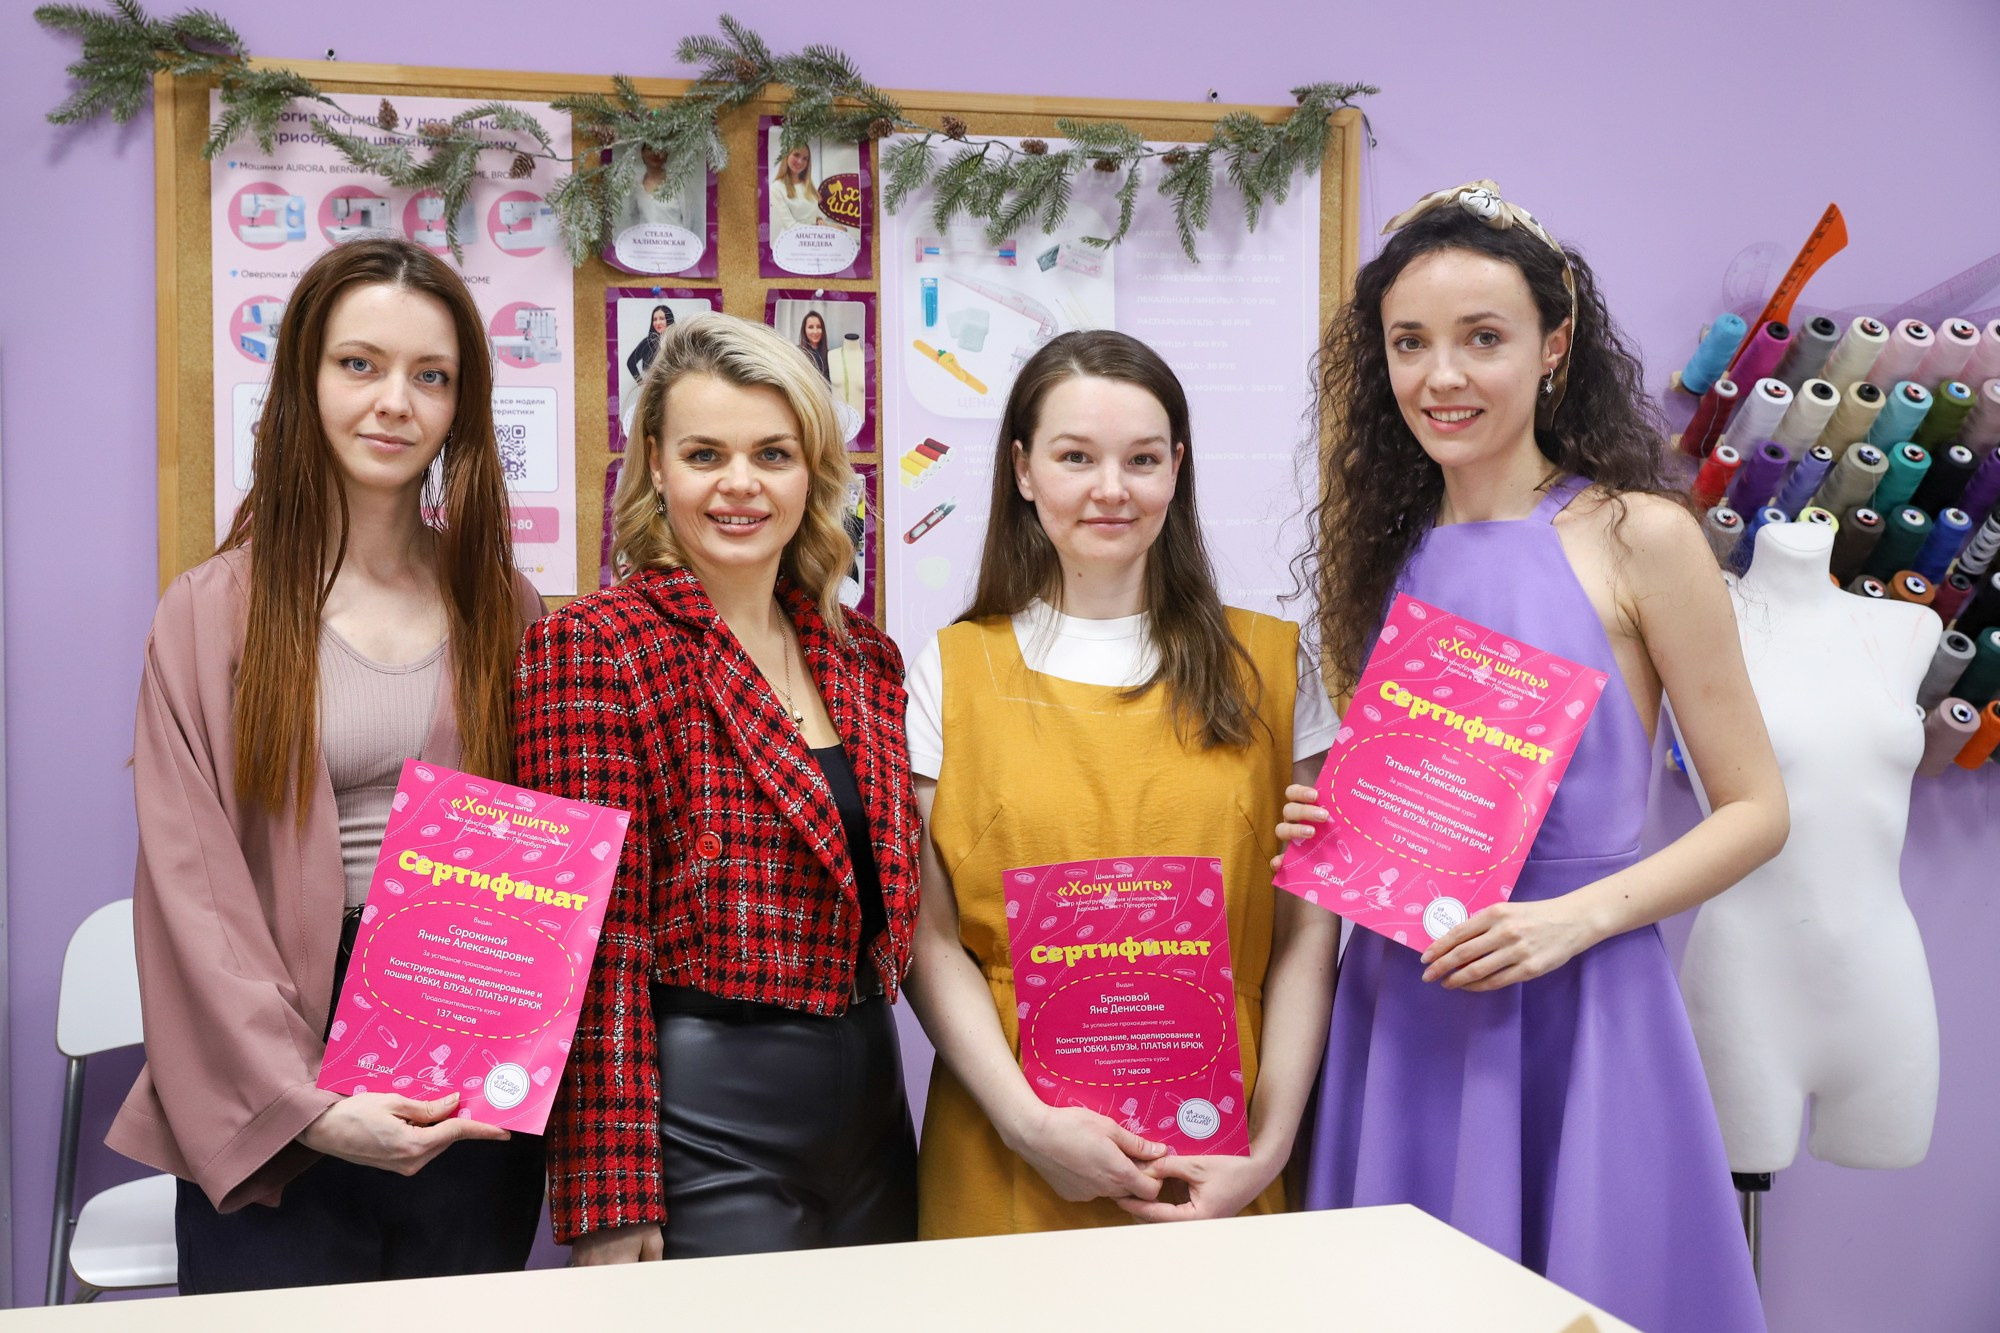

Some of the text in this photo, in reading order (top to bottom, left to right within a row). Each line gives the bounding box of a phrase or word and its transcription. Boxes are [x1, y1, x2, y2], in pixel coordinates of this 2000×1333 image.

[240, 162, 284, 171] Машинки
[644, 230, 674, 238] СТЕЛЛА
[795, 232, 836, 240] АНАСТАСИЯ
[632, 238, 686, 247] ХАЛИМОВСКАЯ
[797, 240, 833, 248] ЛЕБЕДЕВА
[241, 269, 288, 279] Оверлоки
[515, 398, 546, 407] модели
[1438, 637, 1549, 689] «Хочу шить»
[1441, 754, 1459, 766] Выдан
[1420, 758, 1467, 785] Покотило
[1385, 755, 1496, 810] Татьяне Александровне
[494, 798, 514, 808] Школа
[1396, 781, 1424, 796] успешное
[1423, 793, 1461, 812] прохождение
[1461, 809, 1477, 819] курса
[451, 795, 570, 835] «Хочу шить»
[1357, 777, 1426, 814] Конструирование,
[1426, 809, 1488, 840] моделирование
[1350, 788, 1492, 854] пошив ЮБКИ, БЛУЗЫ, ПЛАТЬЯ И БРЮК
[1381, 816, 1452, 852] Продолжительность курса
[1392, 833, 1428, 855] 137 часов
[1057, 880, 1172, 897] «Хочу шить»
[473, 916, 493, 926] Выдан
[448, 924, 508, 947] Сорокиной
[417, 929, 535, 965] Янине Александровне
[422, 949, 521, 978] За успешное прохождение курса
[389, 956, 467, 983] Конструирование,
[468, 977, 536, 997] моделирование
[384, 969, 543, 1010] пошив ЮБКИ, БЛУЗЫ, ПЛАТЬЯ И БРЮК
[421, 992, 483, 1012] Продолжительность
[1100, 992, 1150, 1004] Бряновой
[436, 1008, 477, 1024] 137 часов
[1089, 1004, 1165, 1014] Яне Денисовне
[1056, 1034, 1129, 1044] Конструирование,
[1130, 1032, 1194, 1041] моделирование
[1055, 1041, 1204, 1055] пошив ЮБКИ, БЛУЗЫ, ПЛАТЬЯ И БРЮК
[1094, 1057, 1153, 1066] Продолжительность
[1112, 1068, 1126, 1076] 137
